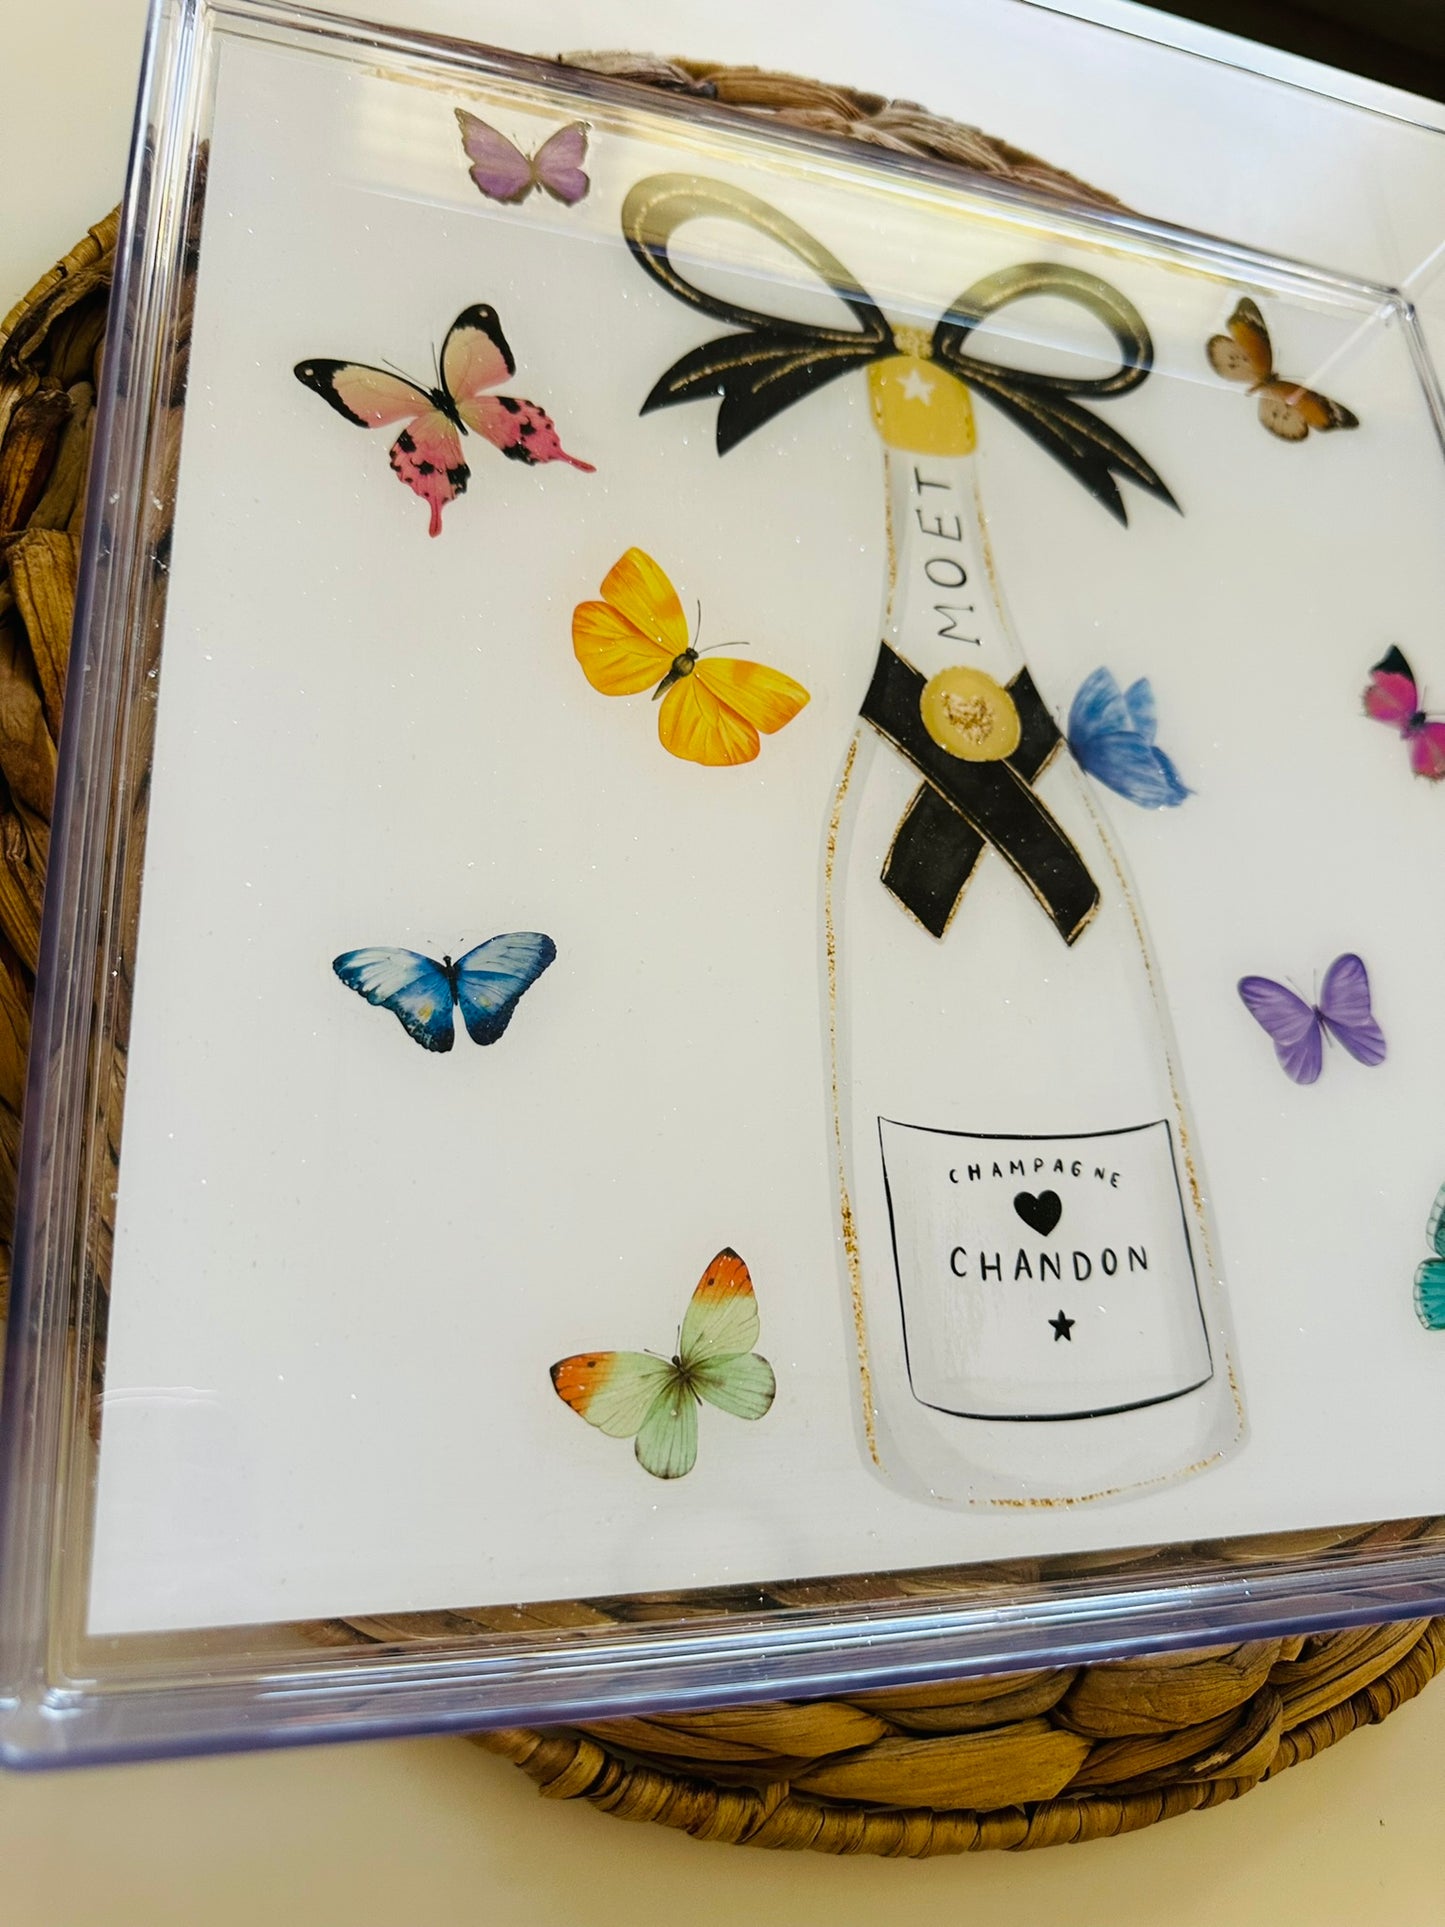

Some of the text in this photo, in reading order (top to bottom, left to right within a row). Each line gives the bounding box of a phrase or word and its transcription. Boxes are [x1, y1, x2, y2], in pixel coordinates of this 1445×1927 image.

[914, 467, 981, 646] MOET
[949, 1157, 1121, 1188] CHAMPAGNE
[949, 1245, 1149, 1281] CHANDON
